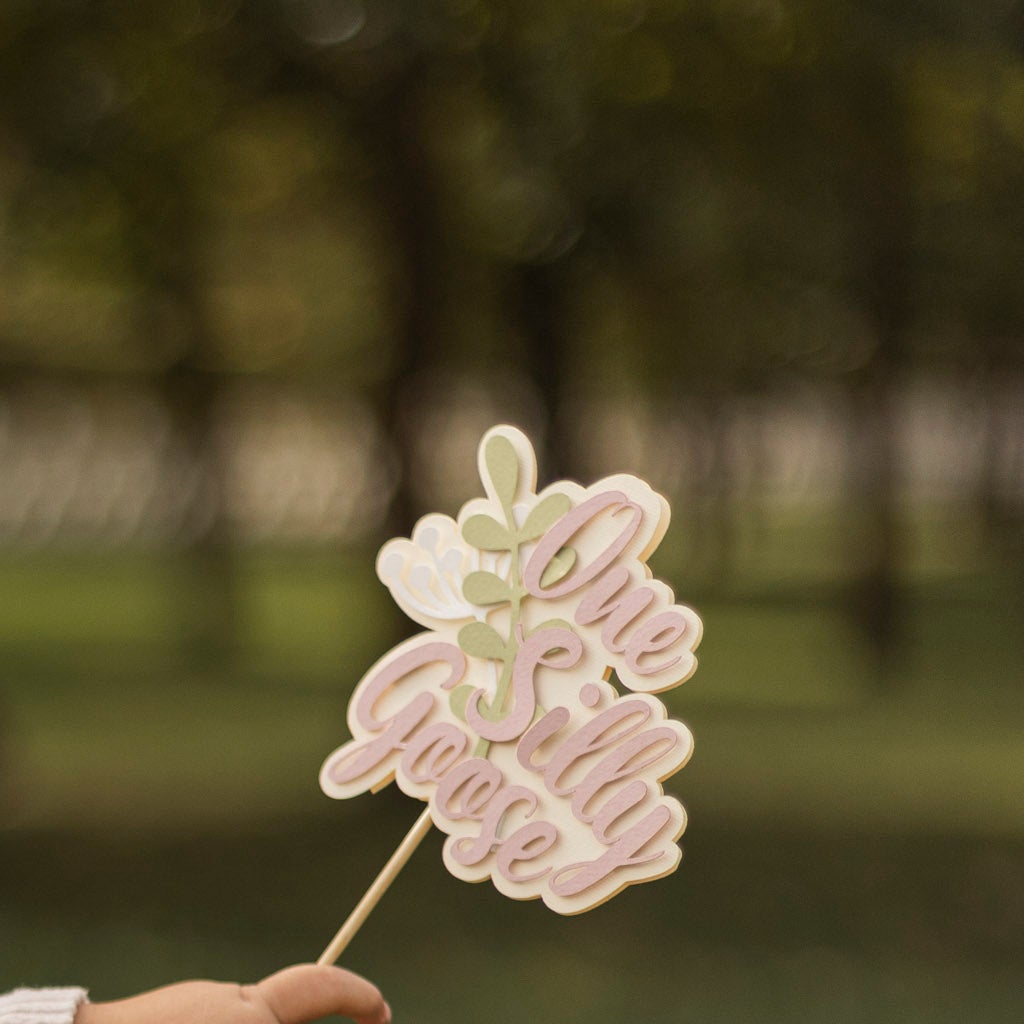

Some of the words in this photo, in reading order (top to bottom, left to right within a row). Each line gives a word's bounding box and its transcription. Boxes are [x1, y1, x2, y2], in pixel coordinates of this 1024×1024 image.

[525, 490, 688, 675] One
[328, 641, 558, 882] Goose
[465, 623, 677, 897] Silly
